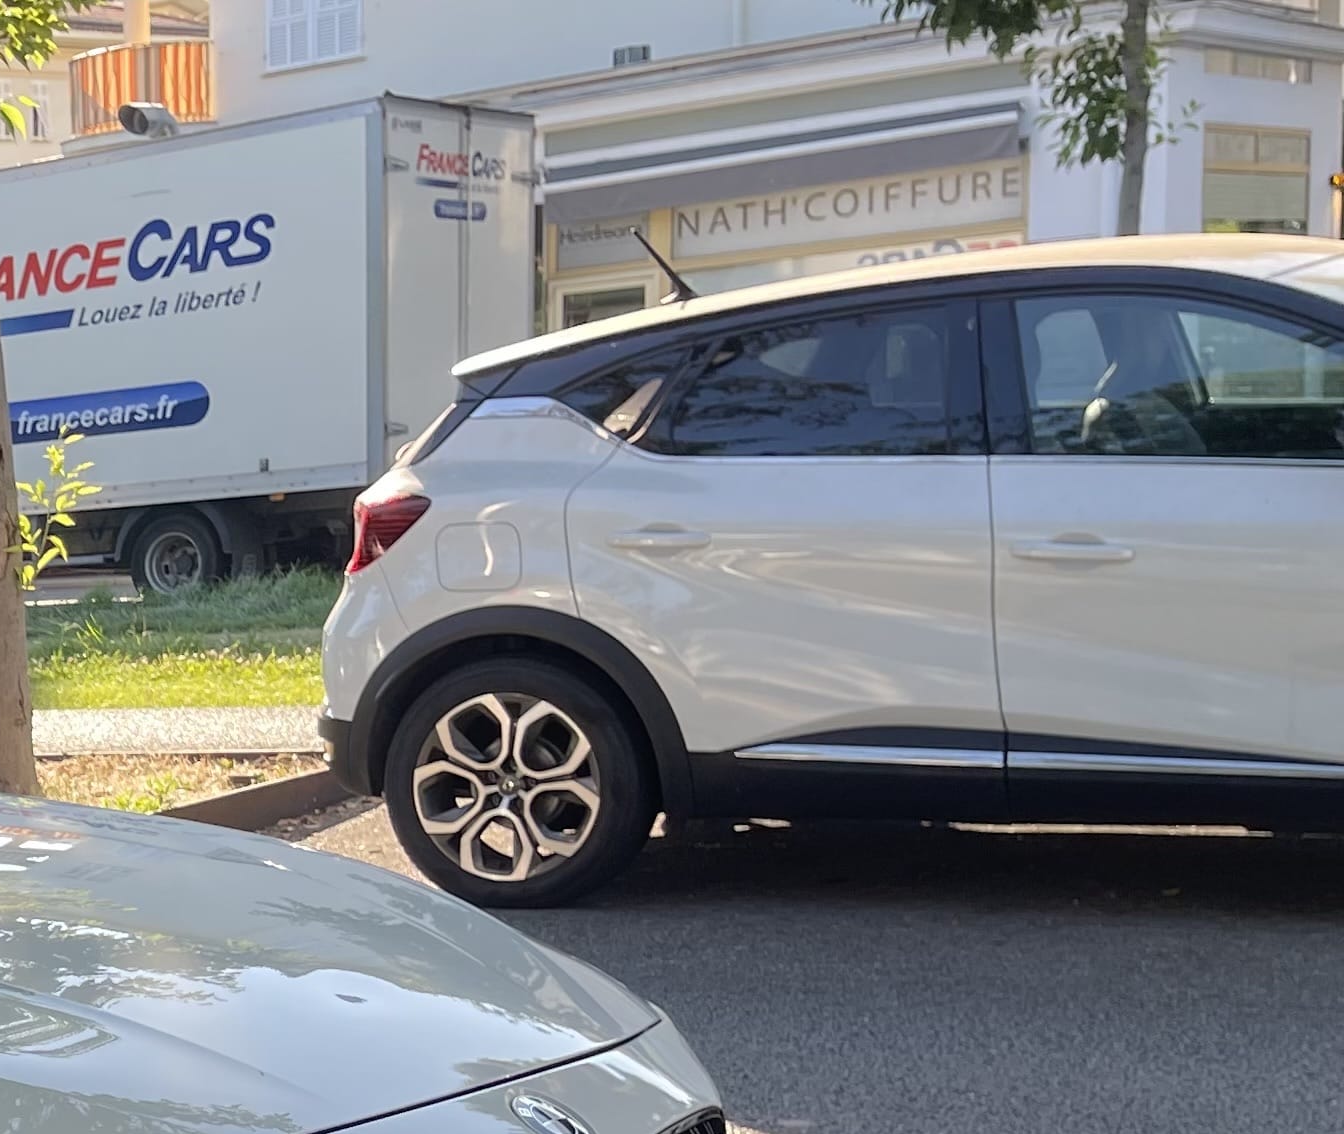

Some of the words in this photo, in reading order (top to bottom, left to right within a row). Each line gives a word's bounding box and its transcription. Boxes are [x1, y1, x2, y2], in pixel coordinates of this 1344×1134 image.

[677, 167, 1020, 239] NATH'COIFFURE
[78, 303, 141, 327] Louez
[149, 297, 167, 317] la
[174, 283, 246, 315] liberté
[17, 394, 179, 435] francecars.fr
